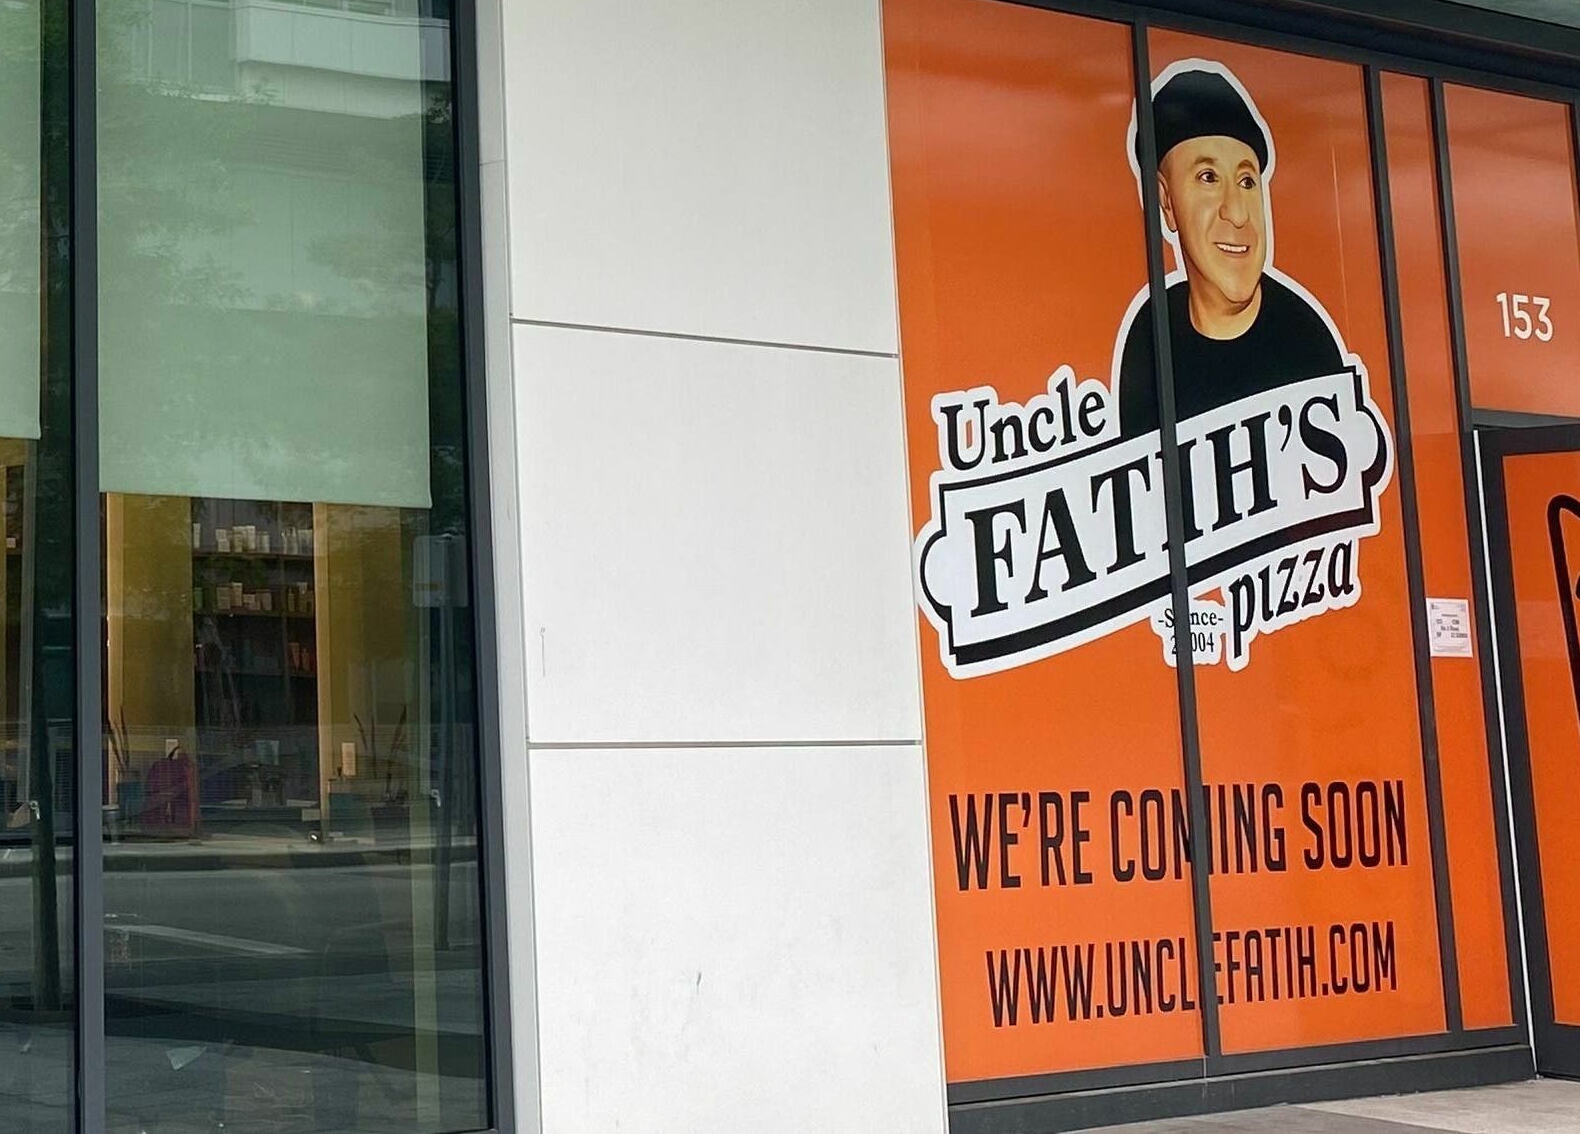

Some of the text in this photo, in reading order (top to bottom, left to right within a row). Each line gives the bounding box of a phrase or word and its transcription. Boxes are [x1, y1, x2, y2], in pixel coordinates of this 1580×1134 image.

[1496, 292, 1553, 341] 153
[940, 377, 1106, 470] Uncle
[965, 393, 1348, 617] FATIH'S
[1158, 608, 1224, 628] -Snce-
[1228, 538, 1355, 659] pizza
[949, 779, 1409, 892] WE'RE COMING SOON
